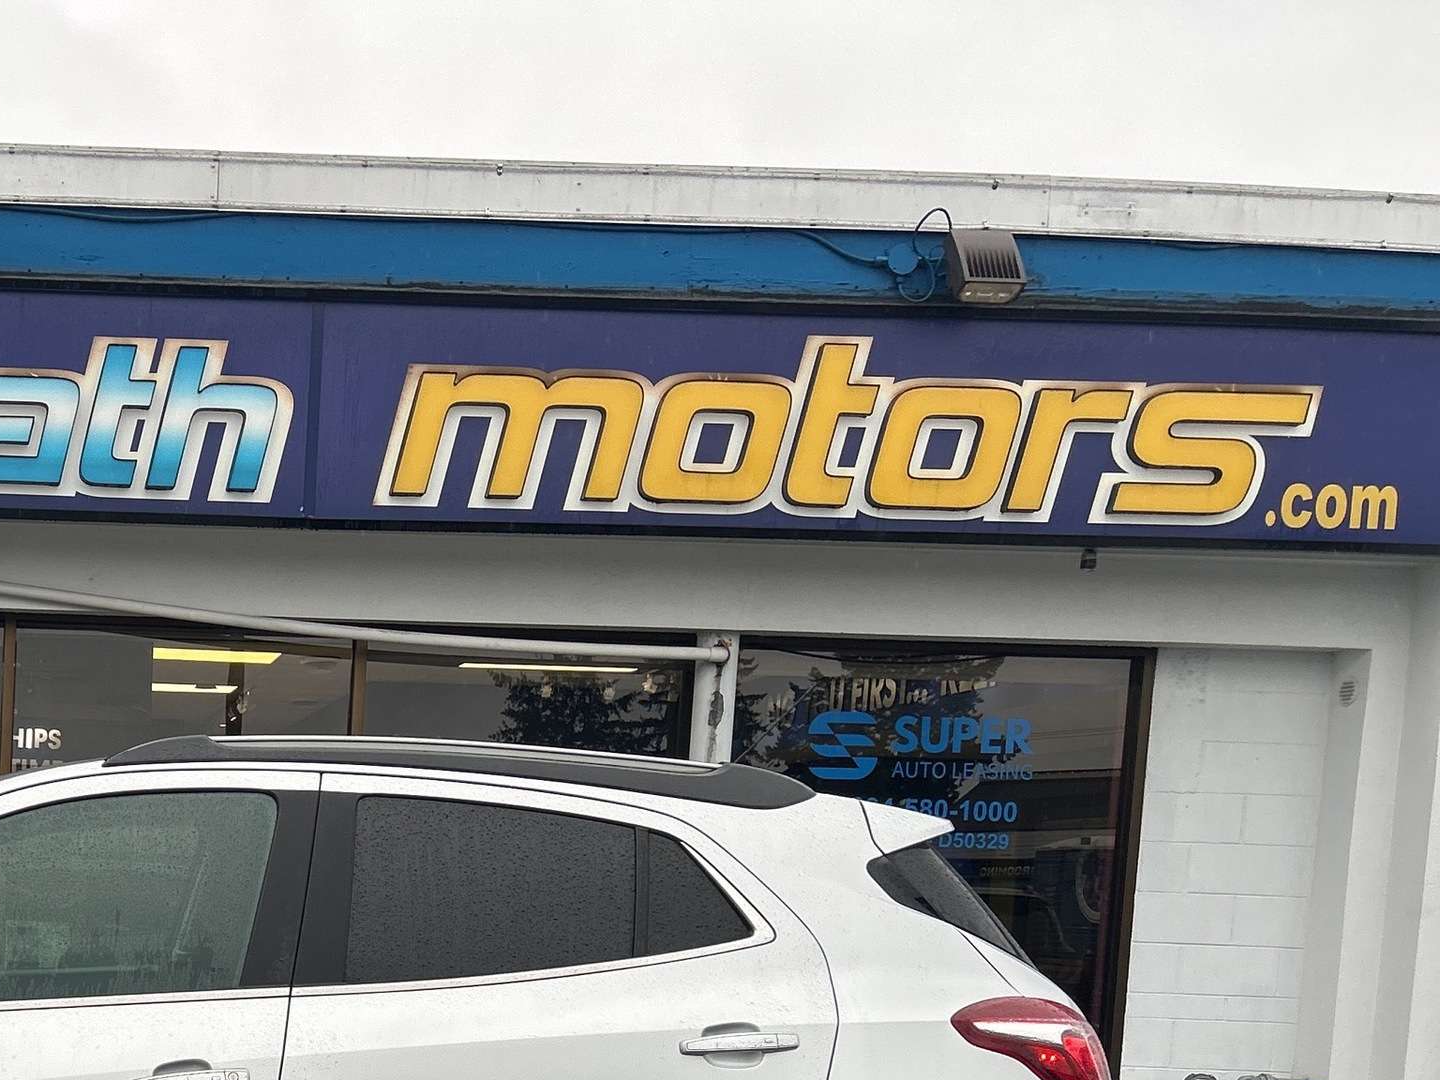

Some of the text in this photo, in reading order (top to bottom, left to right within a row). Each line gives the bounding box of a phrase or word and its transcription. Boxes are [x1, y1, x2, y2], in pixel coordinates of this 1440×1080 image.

[372, 334, 1324, 526] motors
[1265, 483, 1398, 530] .com
[891, 714, 1034, 755] SUPER
[891, 760, 1034, 781] AUTO LEASING
[938, 832, 1009, 850] D50329
